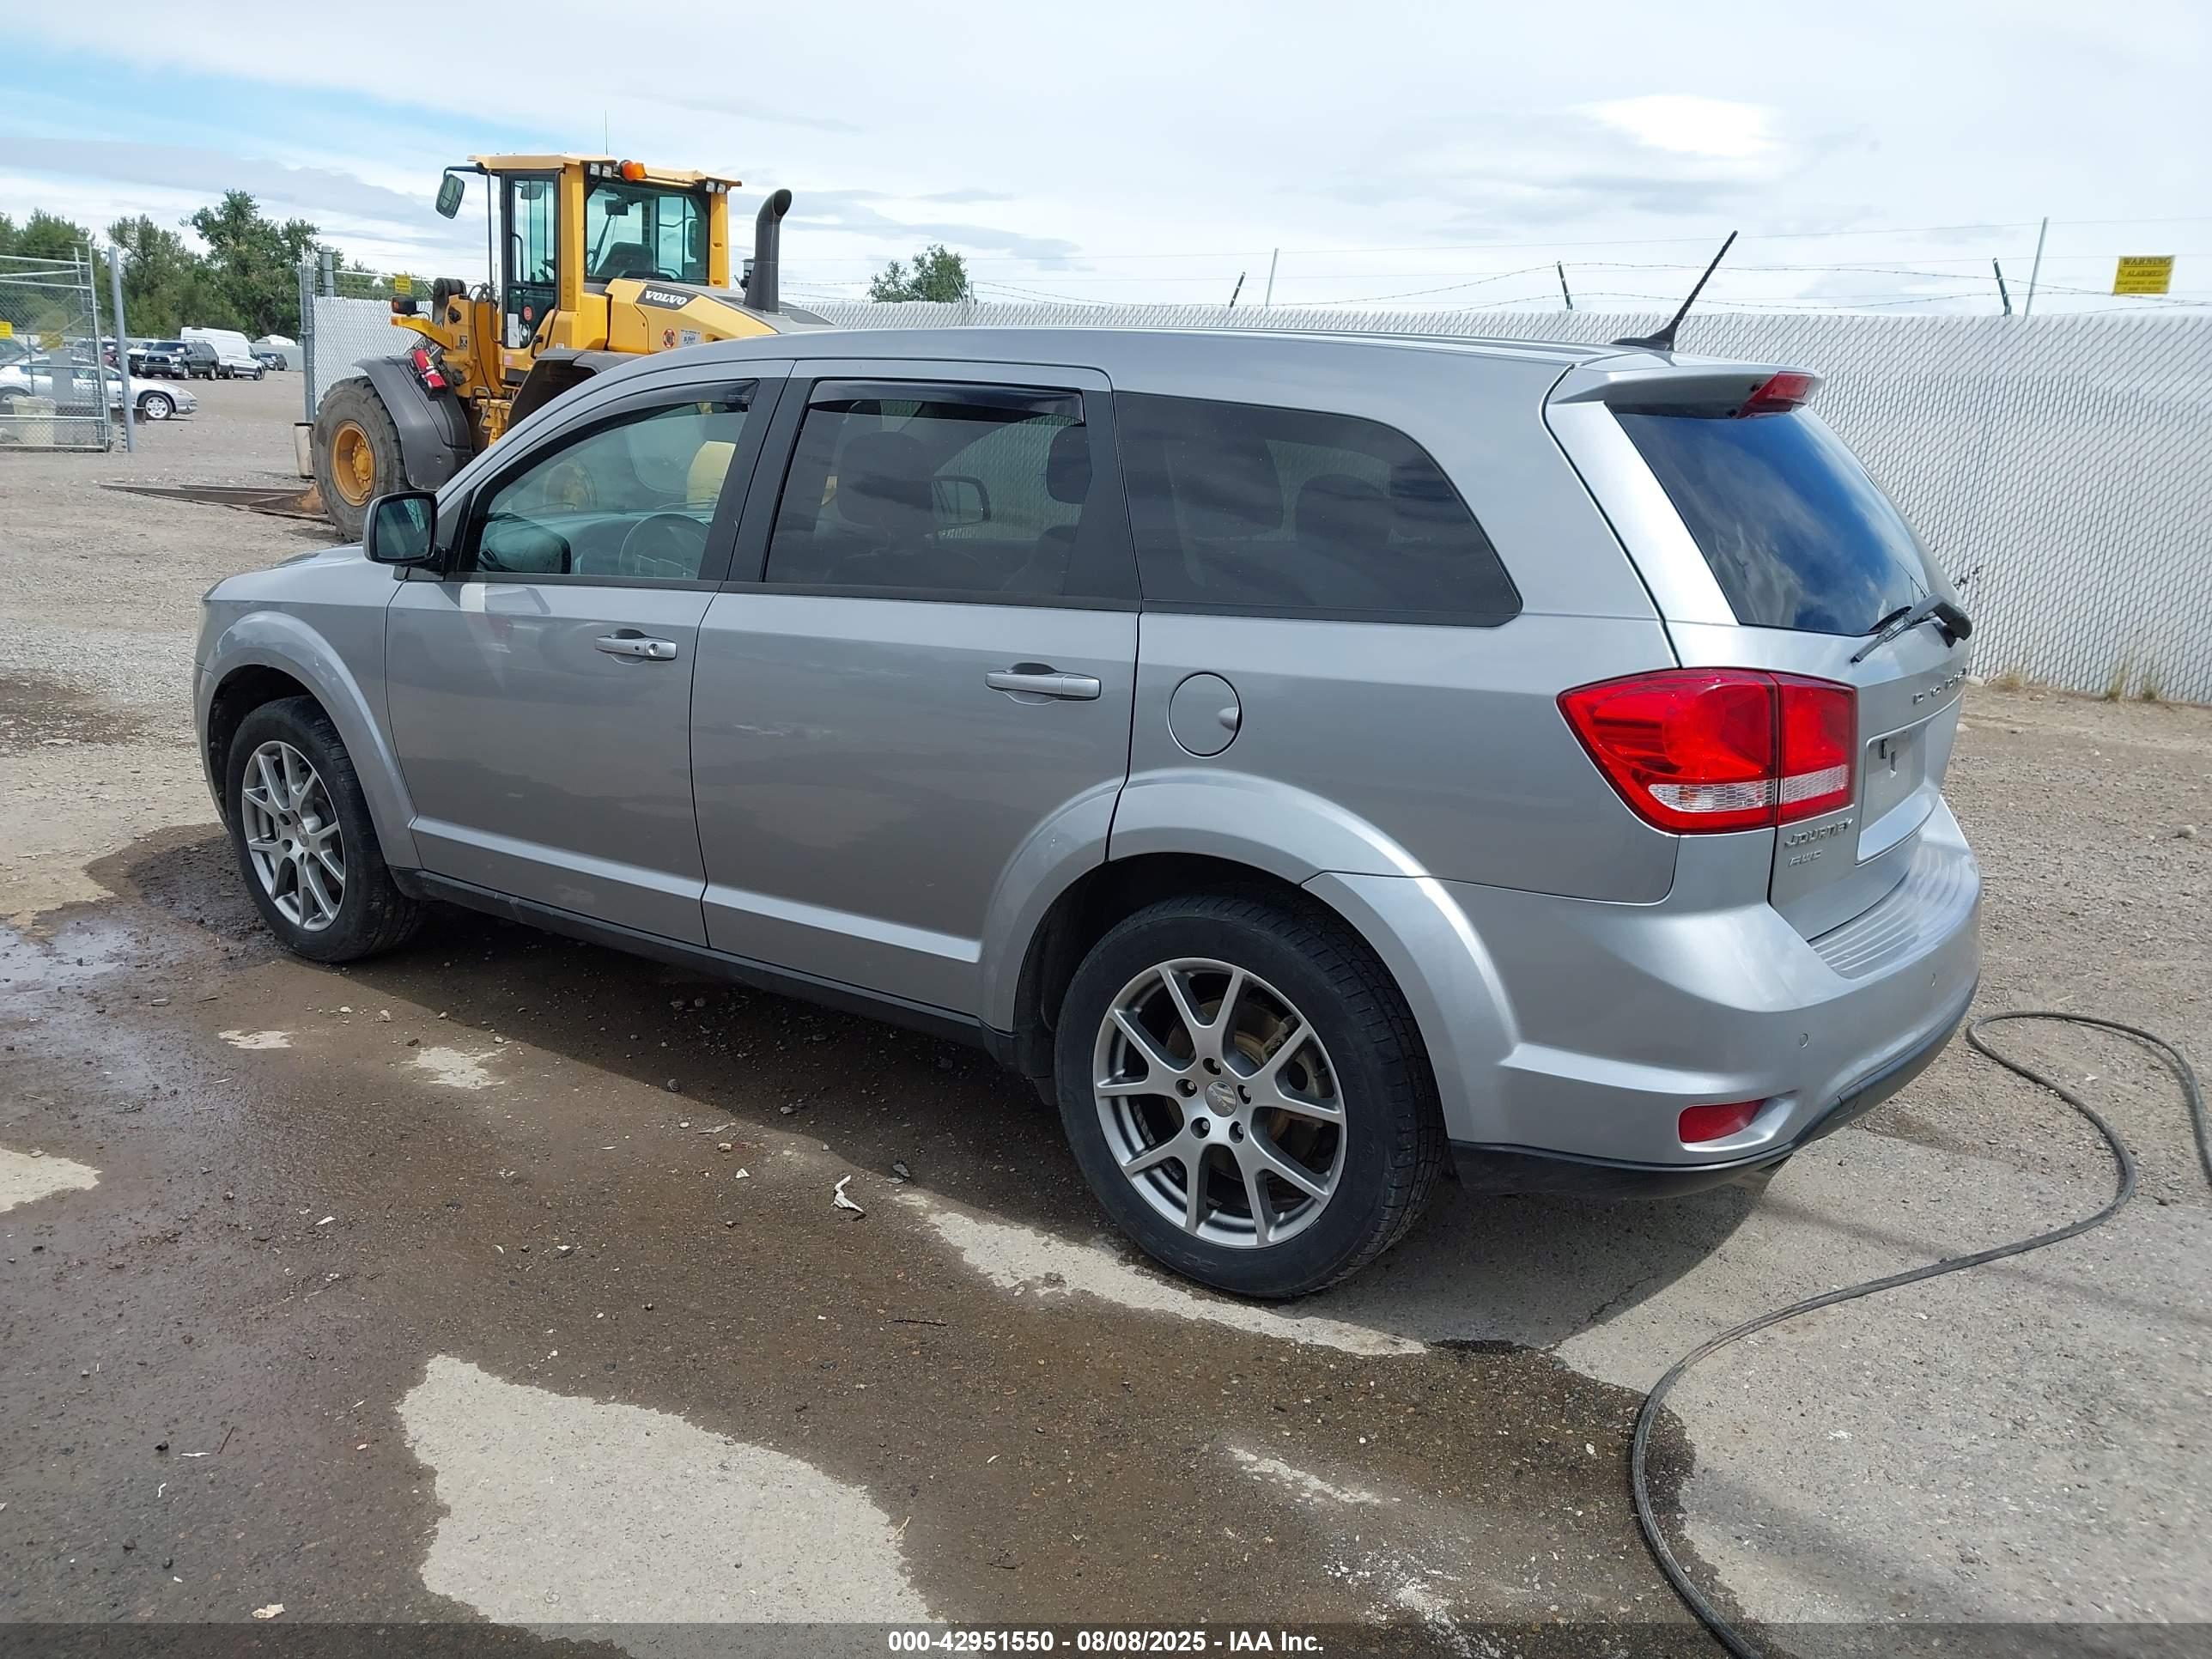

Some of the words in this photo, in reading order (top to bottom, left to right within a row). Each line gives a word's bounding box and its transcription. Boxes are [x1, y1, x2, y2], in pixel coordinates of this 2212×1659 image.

[2123, 257, 2172, 265] WARNING
[645, 290, 688, 306] VOLVO
[1784, 817, 1854, 848] JOURNEY
